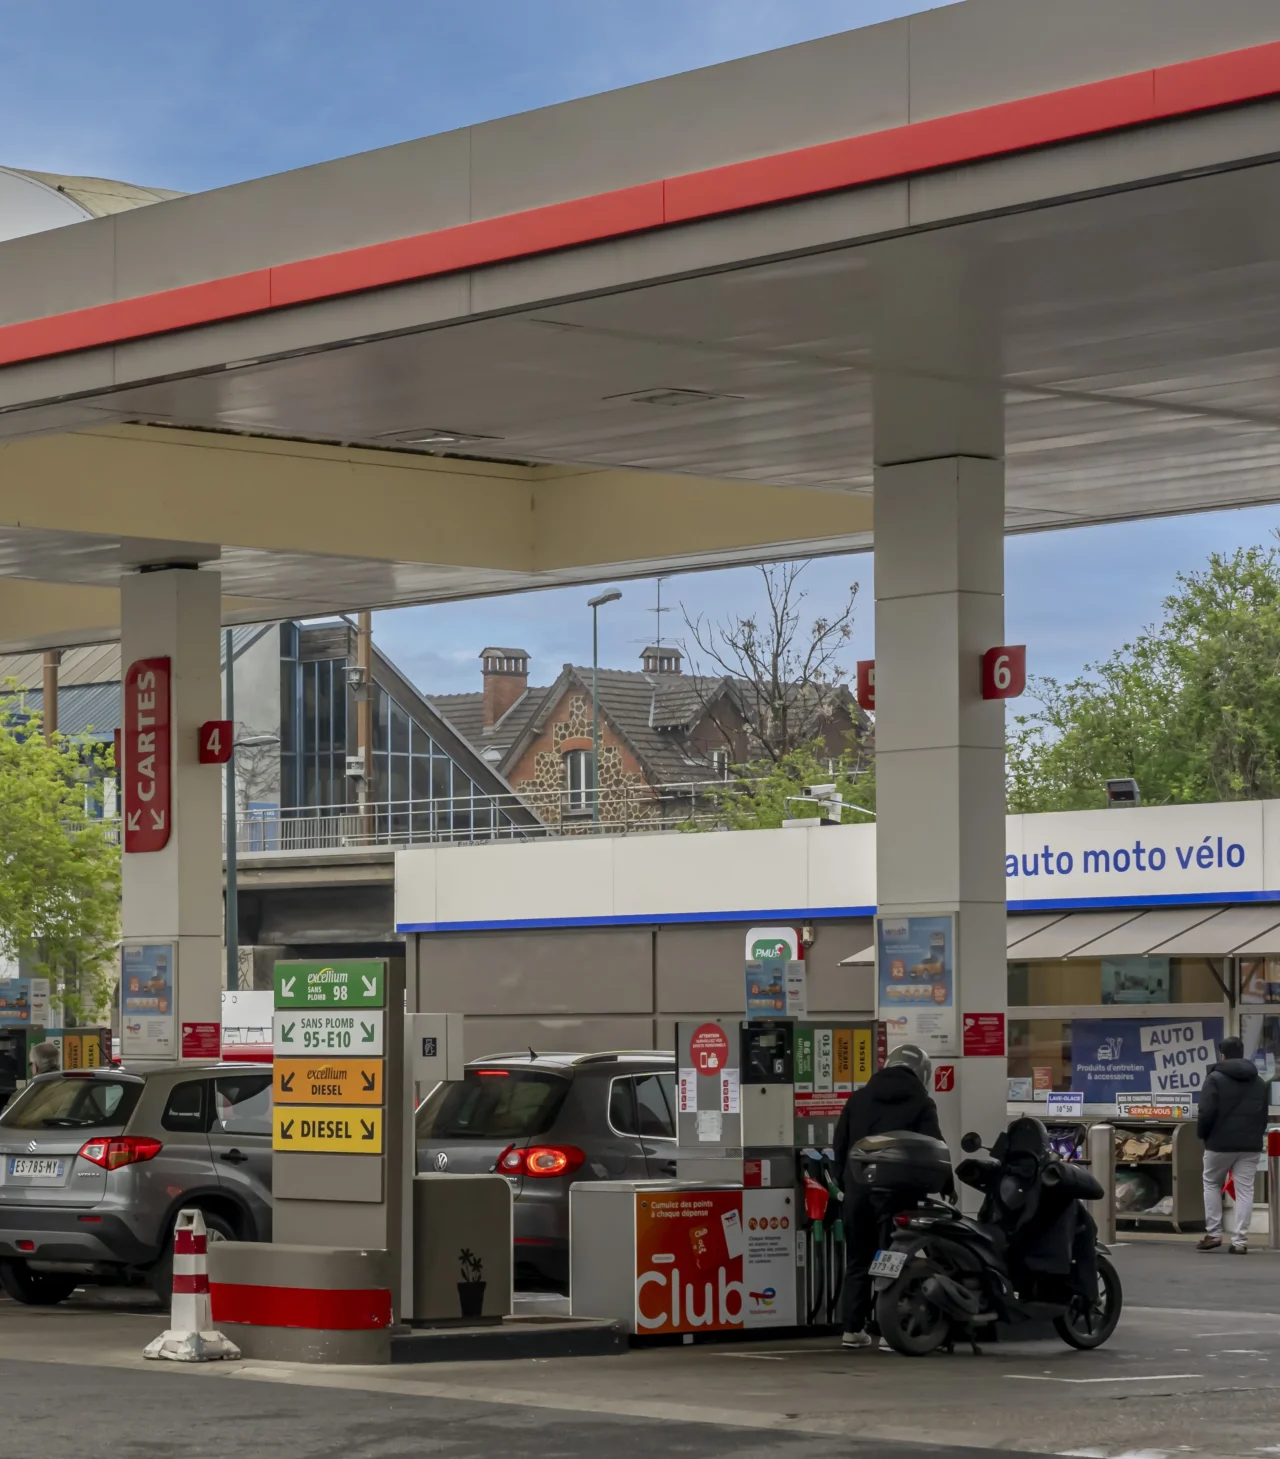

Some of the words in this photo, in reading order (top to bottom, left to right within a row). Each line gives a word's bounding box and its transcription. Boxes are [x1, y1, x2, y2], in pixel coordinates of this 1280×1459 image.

[993, 655, 1011, 689] 6
[137, 671, 155, 801] CARTES
[206, 728, 221, 755] 4
[1006, 844, 1074, 877] auto
[1084, 840, 1166, 873] moto
[1175, 836, 1246, 870] vélo
[756, 948, 774, 958] PMU
[308, 969, 348, 984] excellium
[334, 986, 348, 1000] 98
[301, 1018, 322, 1028] SANS
[326, 1018, 354, 1028] PLOMB
[304, 1031, 351, 1048] 95-E10
[1150, 1026, 1194, 1046] AUTO
[804, 1041, 811, 1054] 98
[1162, 1046, 1208, 1068] MOTO
[307, 1066, 347, 1081] excellium
[775, 1060, 782, 1073] 6
[1158, 1070, 1200, 1090] VÉLO
[311, 1085, 342, 1095] DIESEL
[301, 1121, 352, 1139] DIESEL
[16, 1160, 57, 1173] ES-785-MY
[693, 1200, 713, 1209] points
[656, 1210, 680, 1218] chaque
[682, 1210, 708, 1218] dépense
[694, 1228, 708, 1238] Club
[637, 1266, 744, 1329] Club
